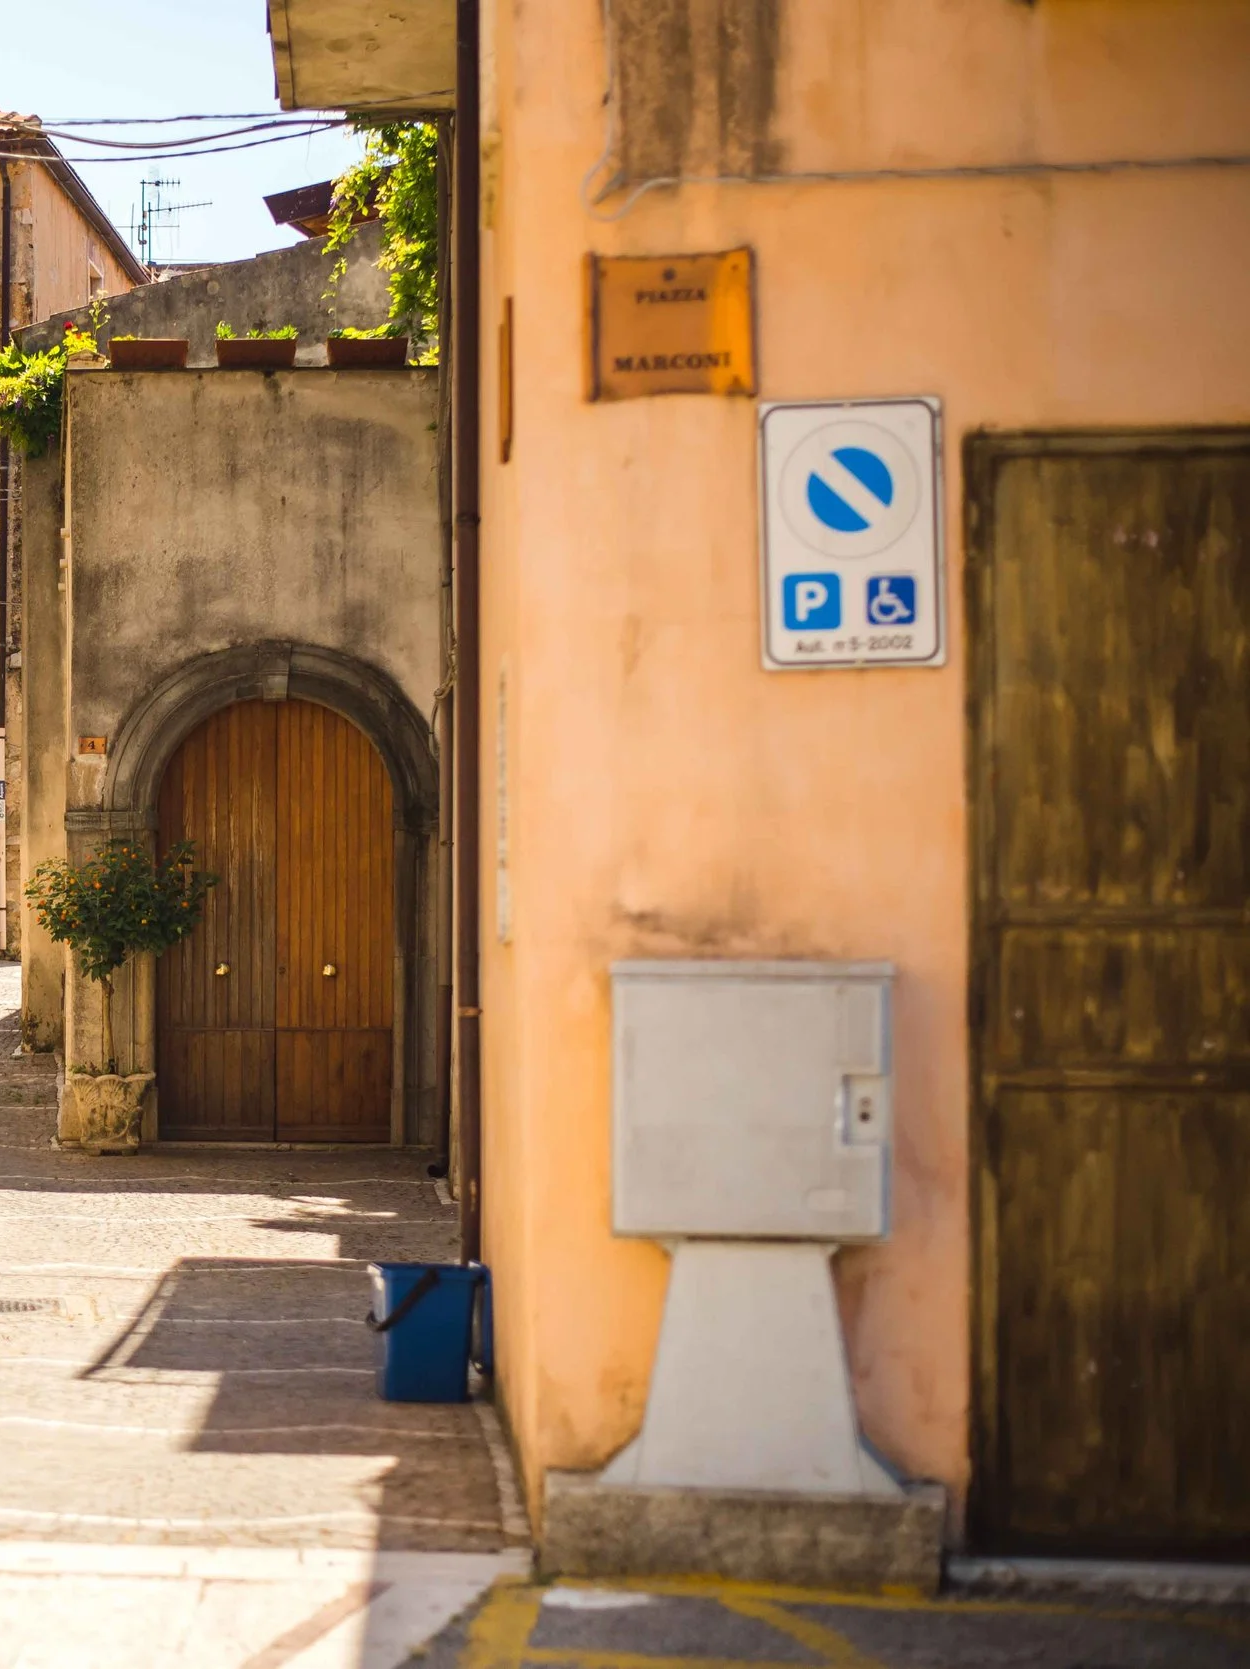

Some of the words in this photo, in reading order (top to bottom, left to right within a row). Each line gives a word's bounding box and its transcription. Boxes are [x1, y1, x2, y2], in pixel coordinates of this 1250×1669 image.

[635, 288, 707, 304] PIAZZA
[613, 352, 731, 373] MARCONI
[795, 581, 828, 622] P
[87, 740, 96, 750] 4
